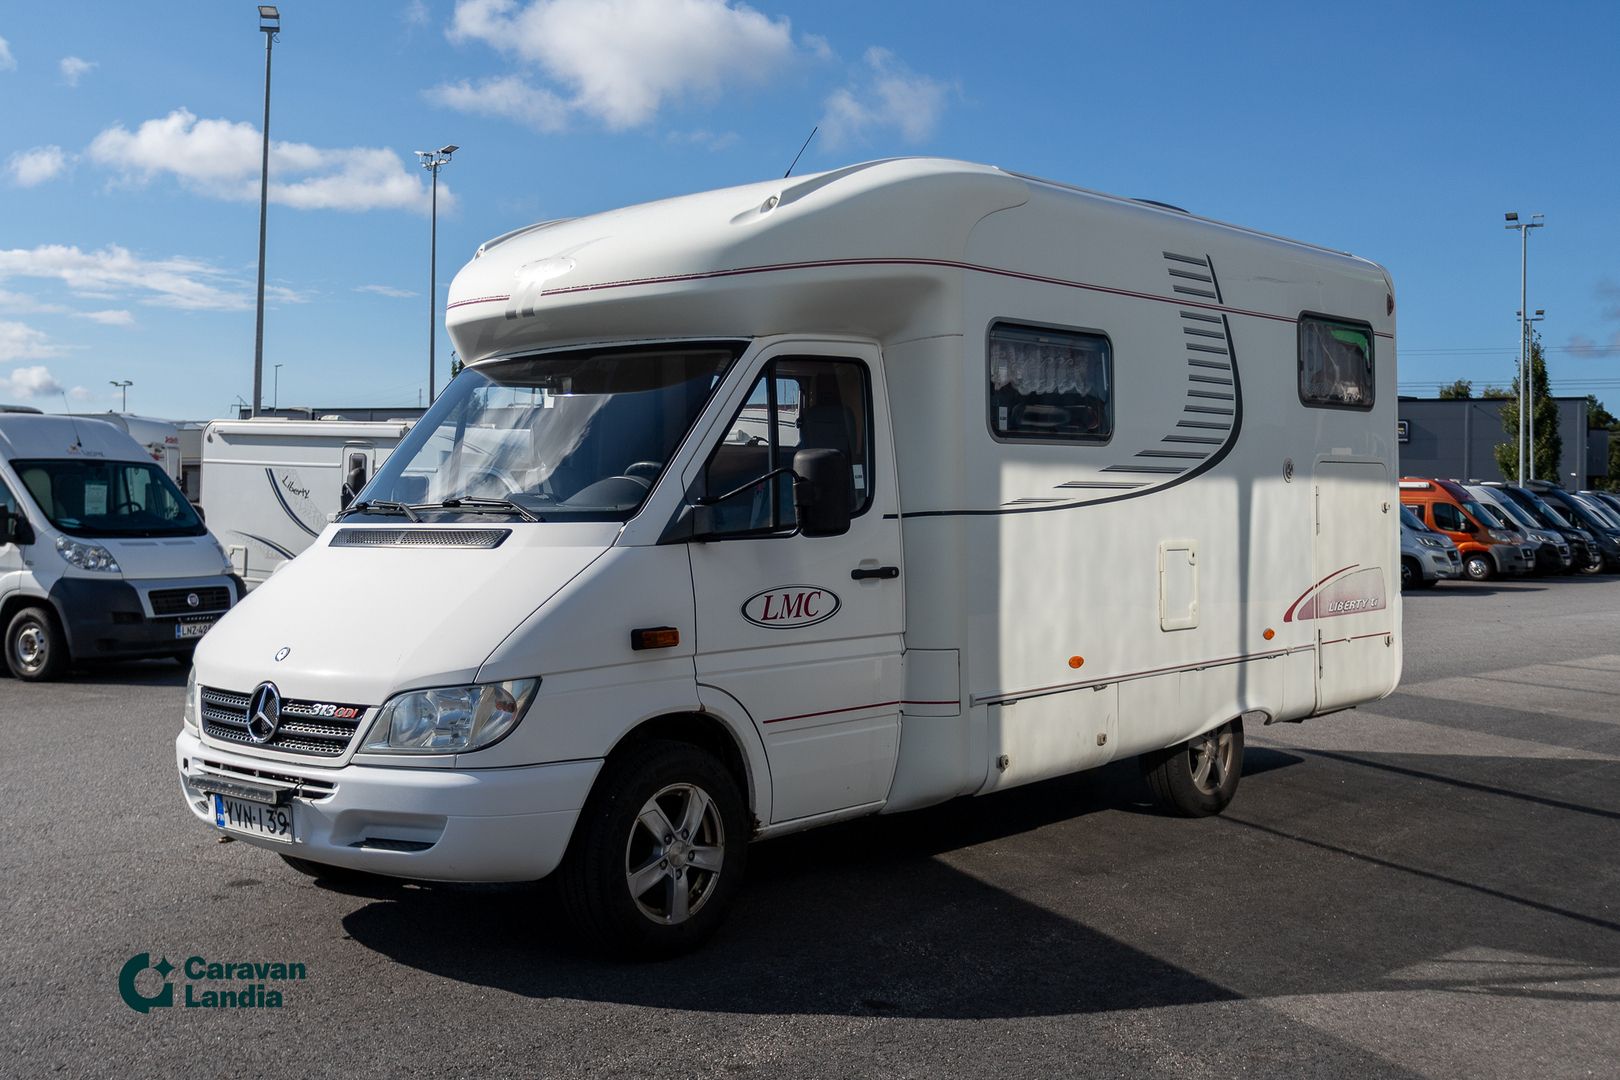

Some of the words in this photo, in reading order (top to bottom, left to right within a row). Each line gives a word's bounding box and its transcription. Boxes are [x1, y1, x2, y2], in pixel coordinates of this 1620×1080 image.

[282, 475, 310, 499] Liberty
[760, 591, 821, 621] LMC
[1328, 599, 1369, 612] LIBERTY
